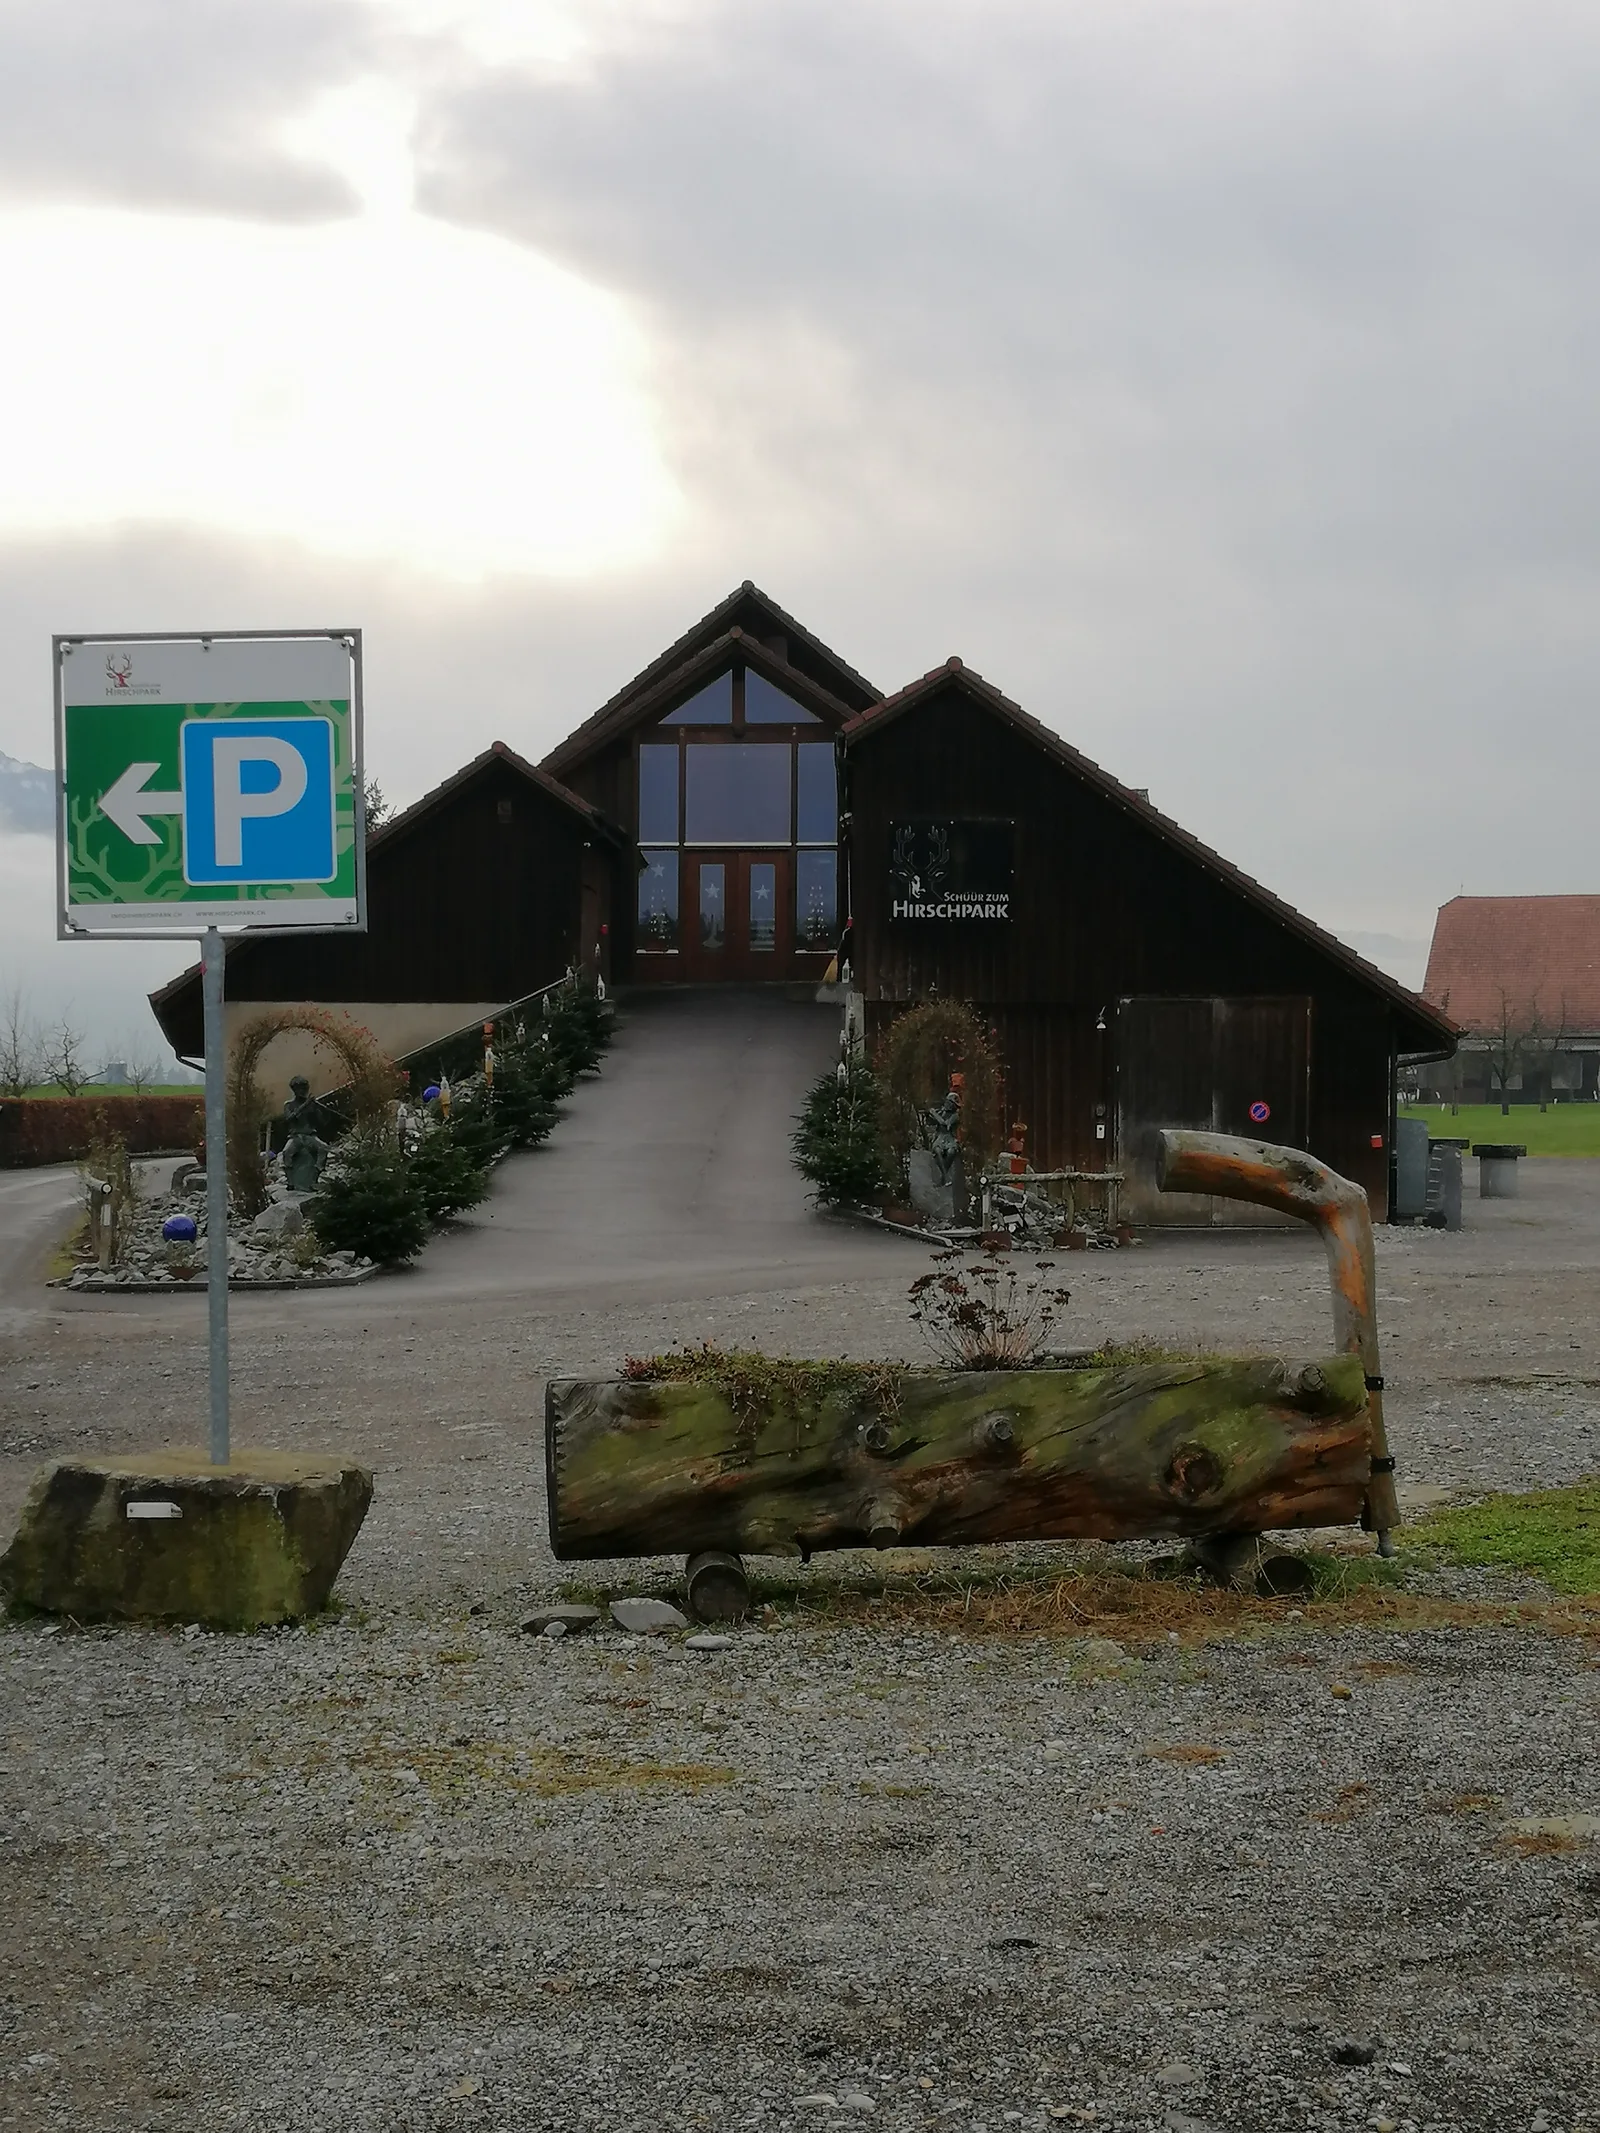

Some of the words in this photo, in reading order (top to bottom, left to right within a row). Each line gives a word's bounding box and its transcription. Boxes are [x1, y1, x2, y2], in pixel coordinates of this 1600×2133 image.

[105, 687, 161, 697] HIRSCHPARK
[212, 736, 309, 867] P
[986, 893, 1010, 902] ZUM
[893, 900, 1009, 918] HIRSCHPARK
